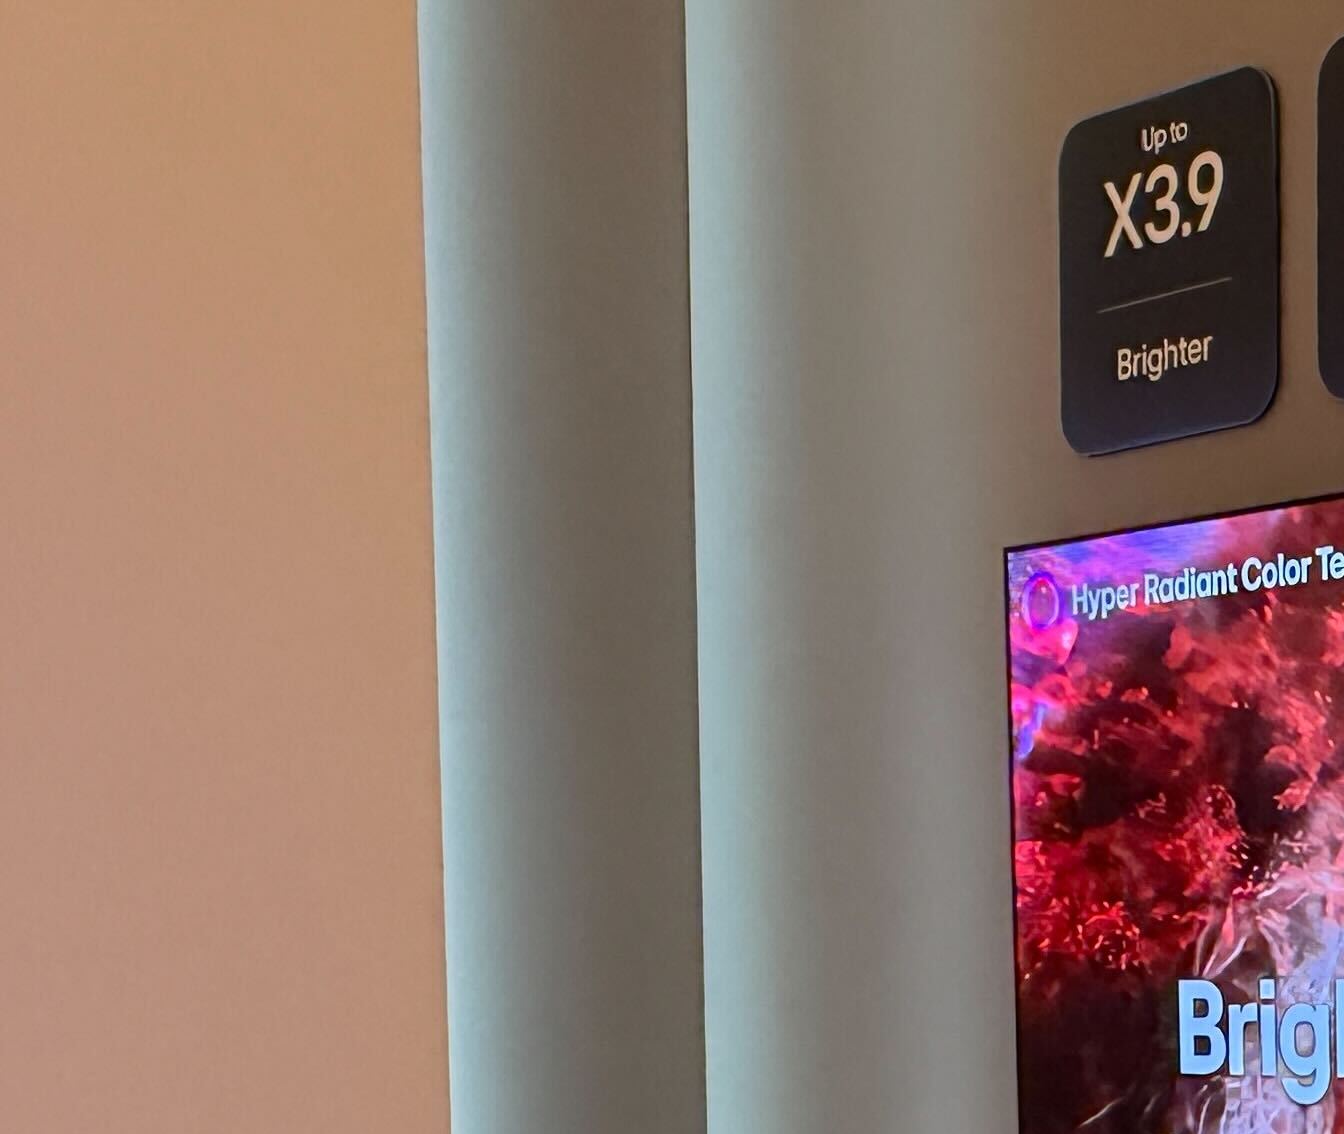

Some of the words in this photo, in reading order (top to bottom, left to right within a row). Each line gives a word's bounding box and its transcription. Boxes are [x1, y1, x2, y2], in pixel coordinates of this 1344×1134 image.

[1141, 126, 1167, 154] Up
[1168, 121, 1188, 144] to
[1104, 150, 1224, 258] X3.9
[1118, 335, 1213, 381] Brighter
[1071, 582, 1140, 621] Hyper
[1144, 561, 1238, 605] Radiant
[1241, 553, 1312, 590] Color
